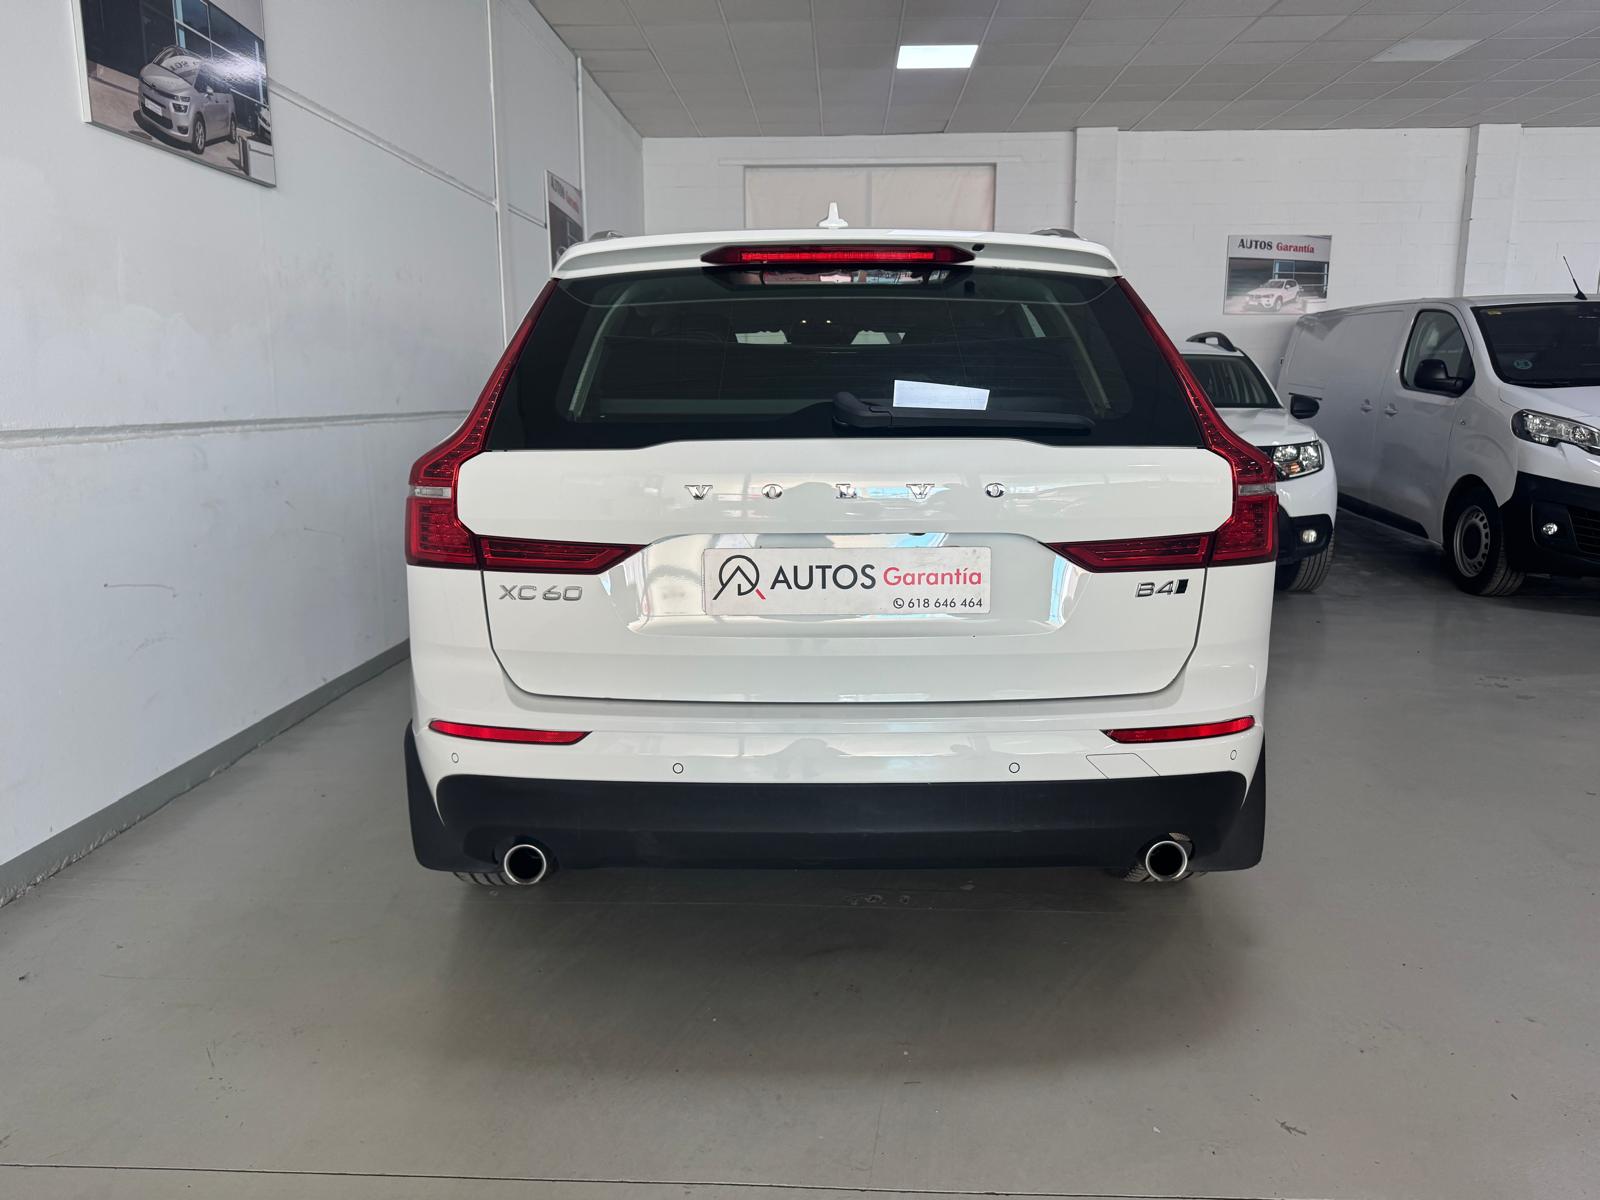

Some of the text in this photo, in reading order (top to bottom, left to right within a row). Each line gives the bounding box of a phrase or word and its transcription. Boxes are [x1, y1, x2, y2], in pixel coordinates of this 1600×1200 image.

[1238, 238, 1315, 253] AUTOS Garantía
[684, 483, 1007, 500] VOLVO
[769, 564, 983, 590] AUTOS Garantía
[1135, 580, 1174, 598] B4
[907, 598, 983, 609] 618 646 464
